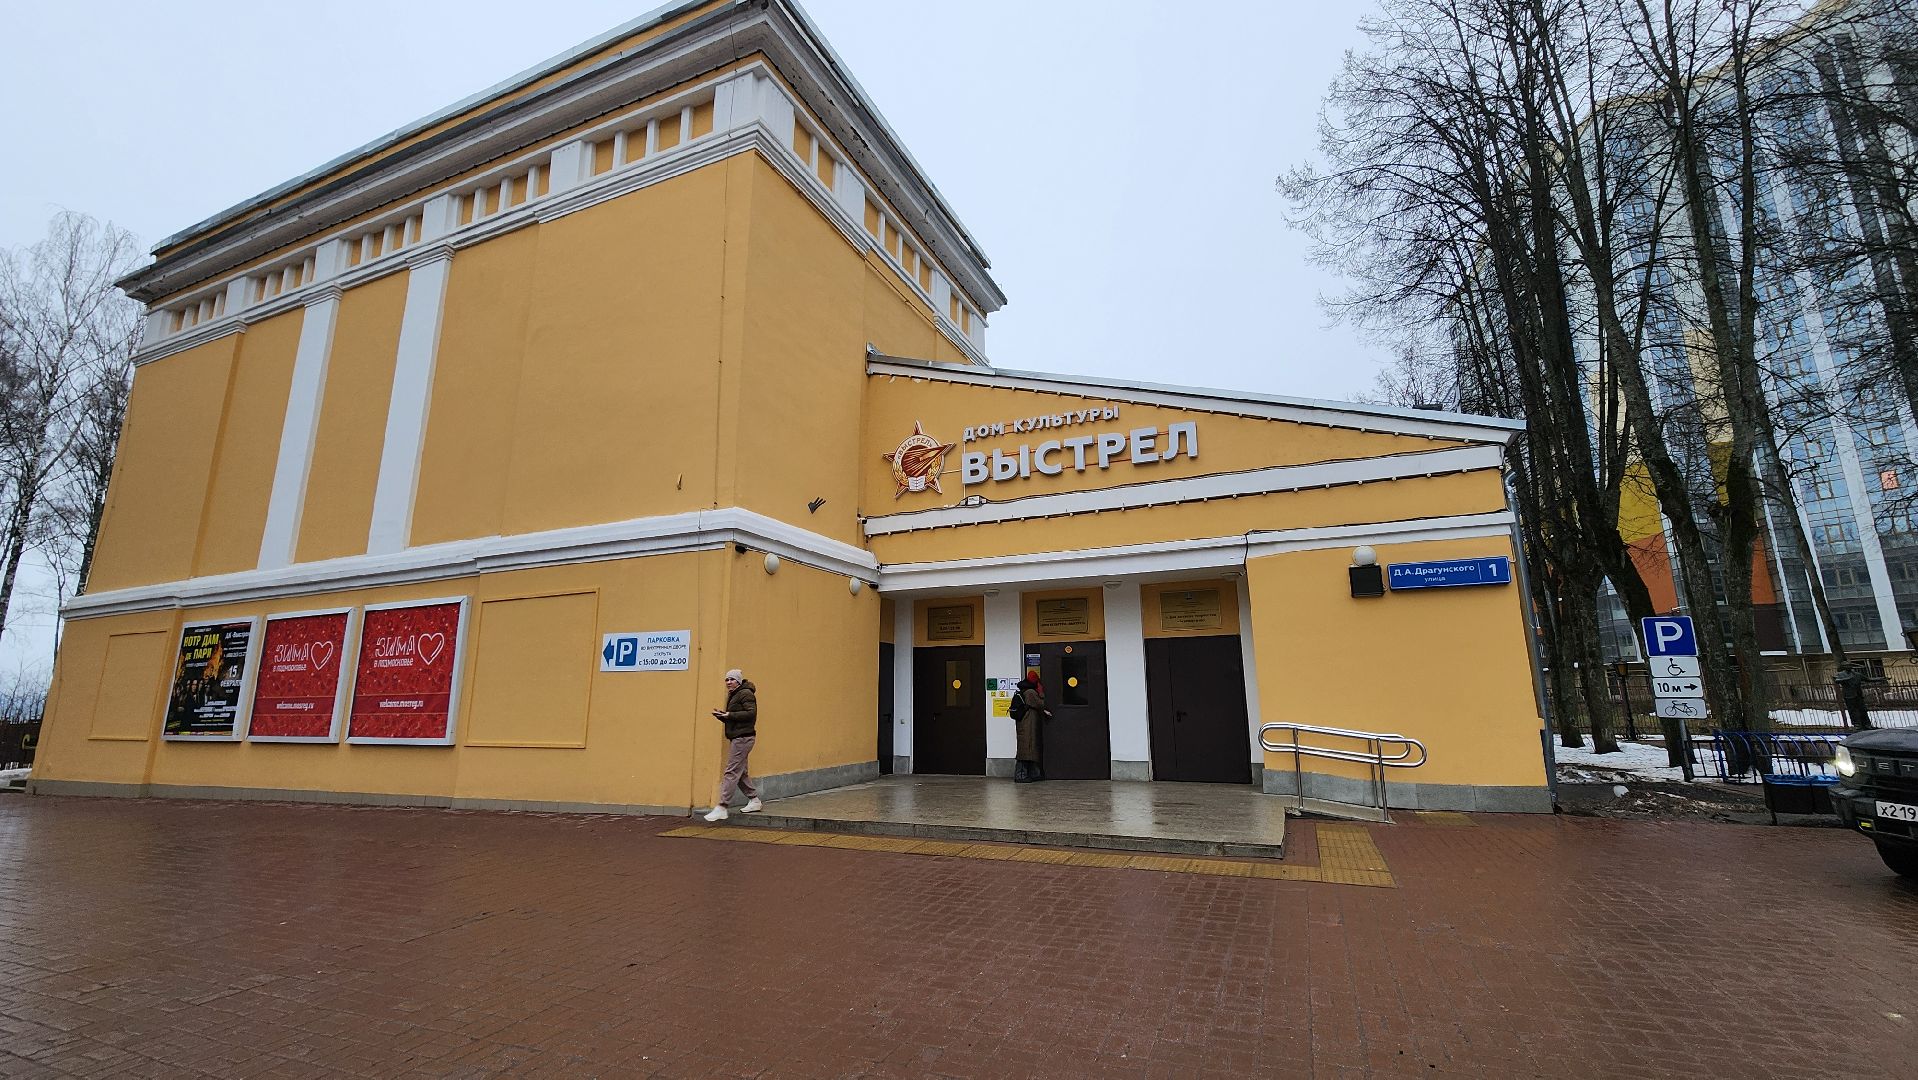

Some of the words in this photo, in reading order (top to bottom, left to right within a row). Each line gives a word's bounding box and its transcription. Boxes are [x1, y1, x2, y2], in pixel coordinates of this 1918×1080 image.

[963, 421, 1005, 443] ДОМ
[1013, 405, 1120, 433] КУЛЬТУРЫ
[962, 421, 1198, 485] ВЫСТРЕЛ
[1488, 563, 1498, 577] 1
[1424, 576, 1446, 584] улица
[183, 635, 201, 648] НОТР
[201, 633, 220, 648] ДАМ
[1654, 621, 1683, 652] P
[193, 647, 213, 660] ПАРИ
[274, 643, 309, 663] ЗИМА
[375, 635, 416, 657] ЗИМА
[619, 641, 633, 663] P
[643, 658, 659, 666] 15:00
[669, 657, 687, 665] 22:00
[228, 665, 238, 678] 15
[1657, 682, 1670, 693] 10
